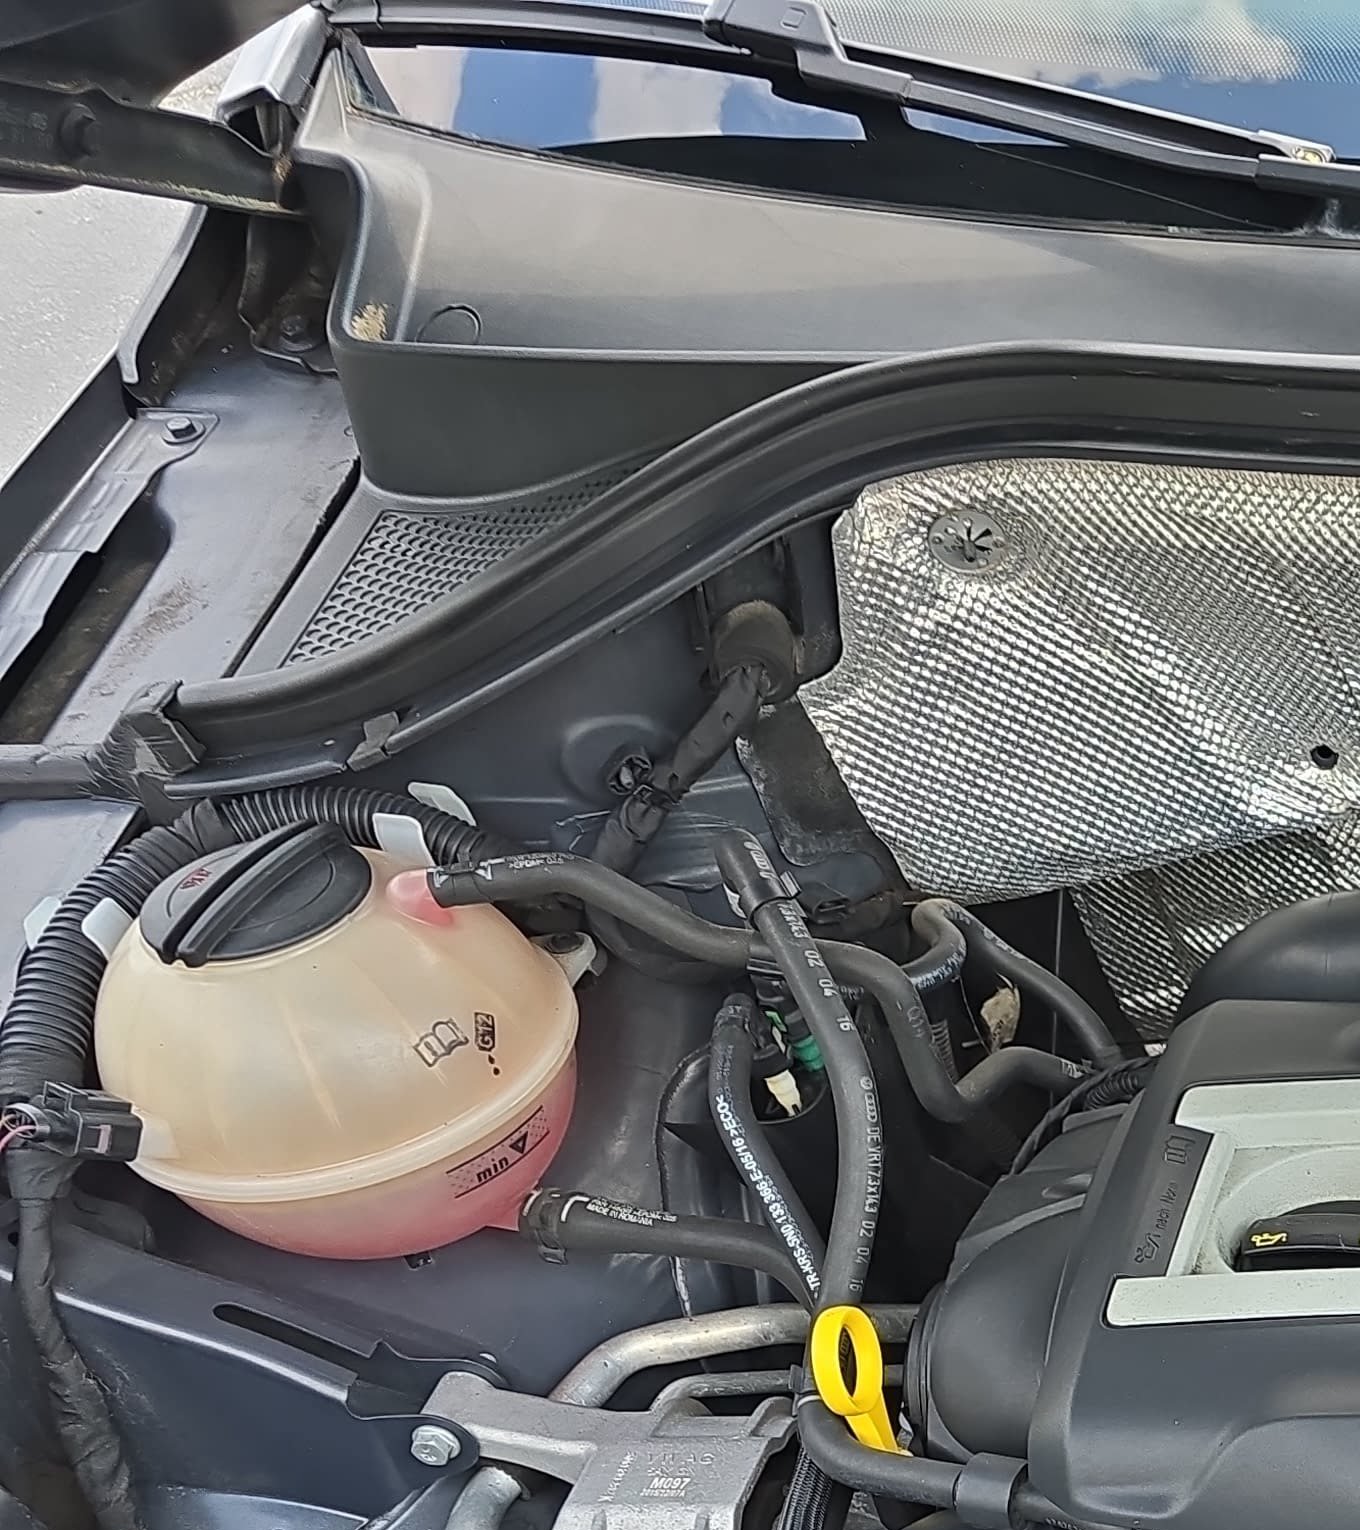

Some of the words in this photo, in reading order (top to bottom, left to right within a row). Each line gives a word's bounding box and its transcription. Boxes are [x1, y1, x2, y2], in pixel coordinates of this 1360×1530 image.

[804, 950, 825, 968] 02
[818, 978, 838, 998] 04
[837, 1015, 856, 1032] 16
[477, 1156, 509, 1182] min
[755, 1179, 777, 1204] 366
[768, 1201, 788, 1227] 133
[860, 1220, 873, 1237] 02
[855, 1247, 868, 1263] 04
[650, 1478, 691, 1489] M097
